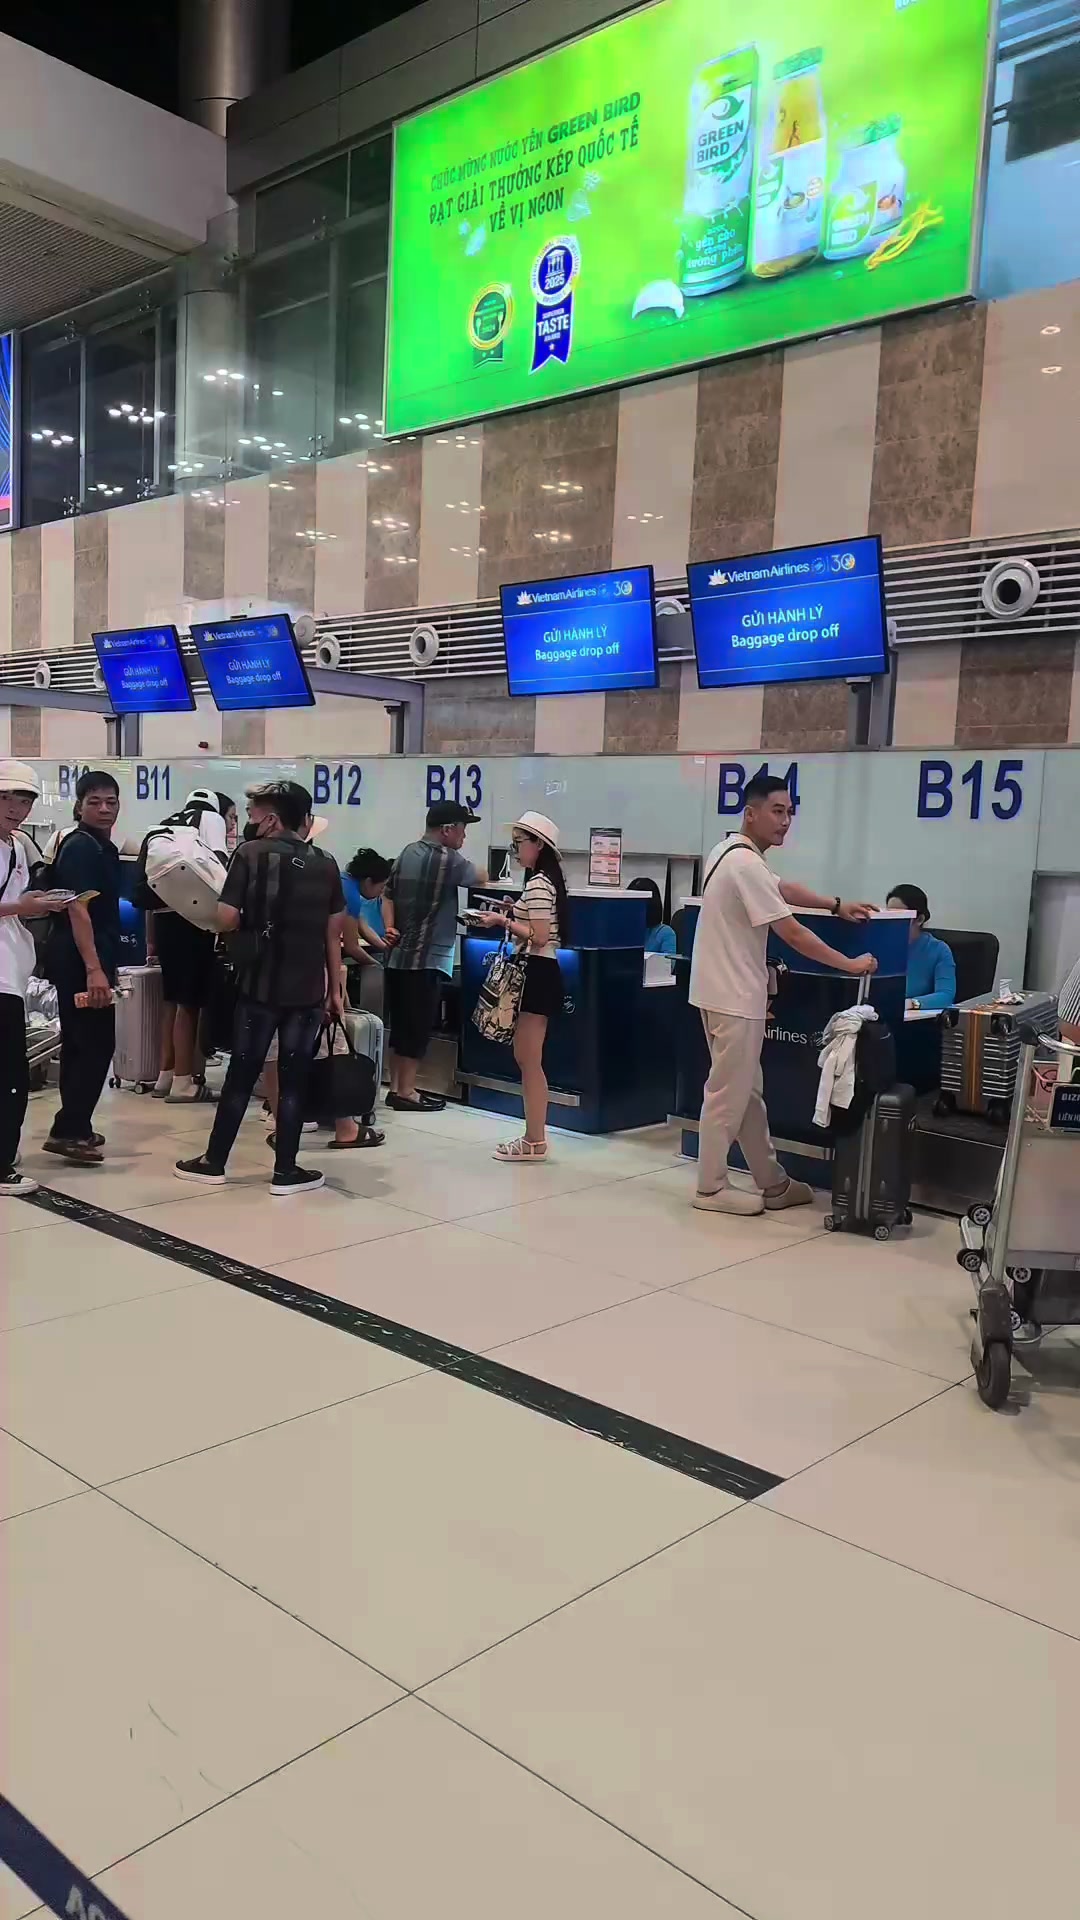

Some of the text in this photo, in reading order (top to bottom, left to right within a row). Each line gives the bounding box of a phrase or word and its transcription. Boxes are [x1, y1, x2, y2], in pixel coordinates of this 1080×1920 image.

[547, 109, 598, 144] GREEN
[603, 92, 641, 122] BIRD
[698, 120, 744, 147] GREEN
[697, 141, 730, 163] BIRD
[429, 115, 639, 226] ĐẠT GIẢI THƯỞNG KÉP QUỐC TẾ
[489, 187, 564, 232] VỀ VỊ NGON
[537, 314, 569, 336] TASTE
[742, 603, 824, 628] GỬI HÀNH LÝ
[543, 624, 608, 644] GỬI HÀNH LÝ
[731, 623, 840, 649] Baggage drop off
[535, 642, 620, 662] Baggage drop off
[226, 674, 255, 686] Baggage
[255, 672, 271, 682] drop
[137, 765, 170, 800] B11
[314, 764, 362, 805] B12
[426, 764, 482, 809] B13
[917, 760, 1023, 820] B15
[764, 1026, 807, 1044] irlines
